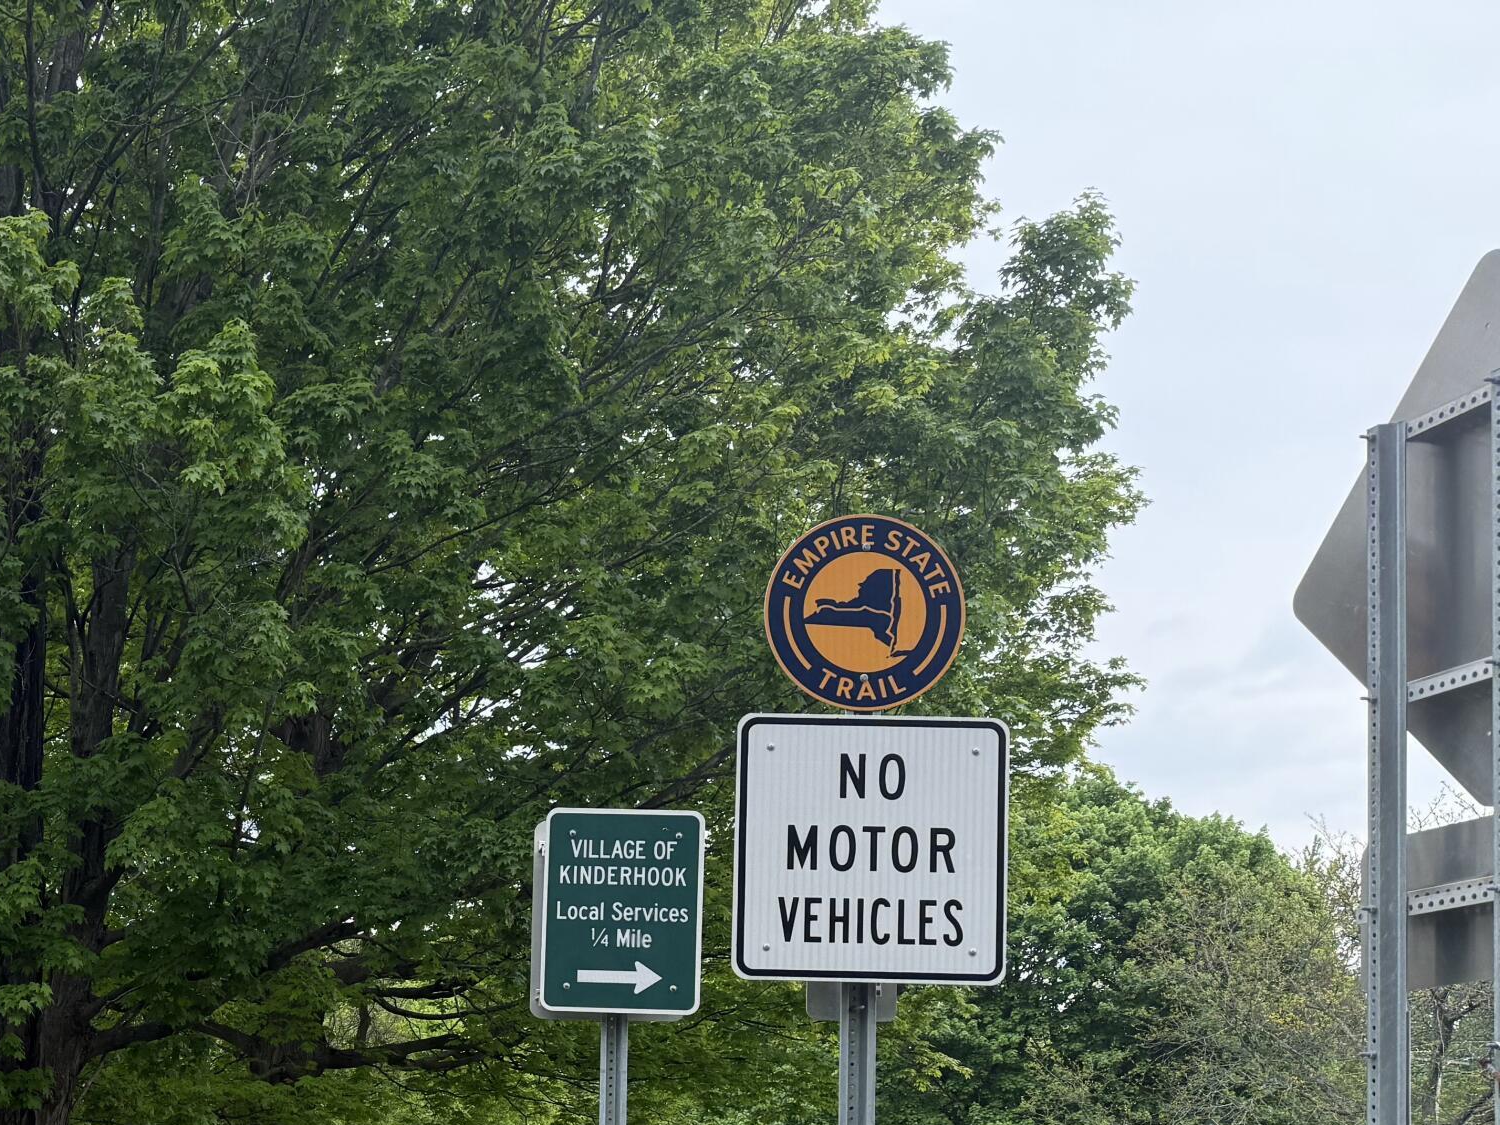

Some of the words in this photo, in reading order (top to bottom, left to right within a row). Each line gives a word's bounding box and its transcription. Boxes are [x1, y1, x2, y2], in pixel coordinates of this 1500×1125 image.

[782, 525, 874, 590] EMPIRE
[884, 530, 950, 599] STATE
[818, 668, 907, 700] TRAIL
[839, 753, 906, 800] NO
[571, 839, 646, 859] VILLAGE
[653, 840, 677, 860] OF
[786, 824, 956, 873] MOTOR
[559, 865, 687, 887] KINDERHOOK
[556, 901, 604, 921] Local
[611, 902, 688, 922] Services
[778, 897, 963, 947] VEHICLES
[616, 929, 652, 948] Mile
